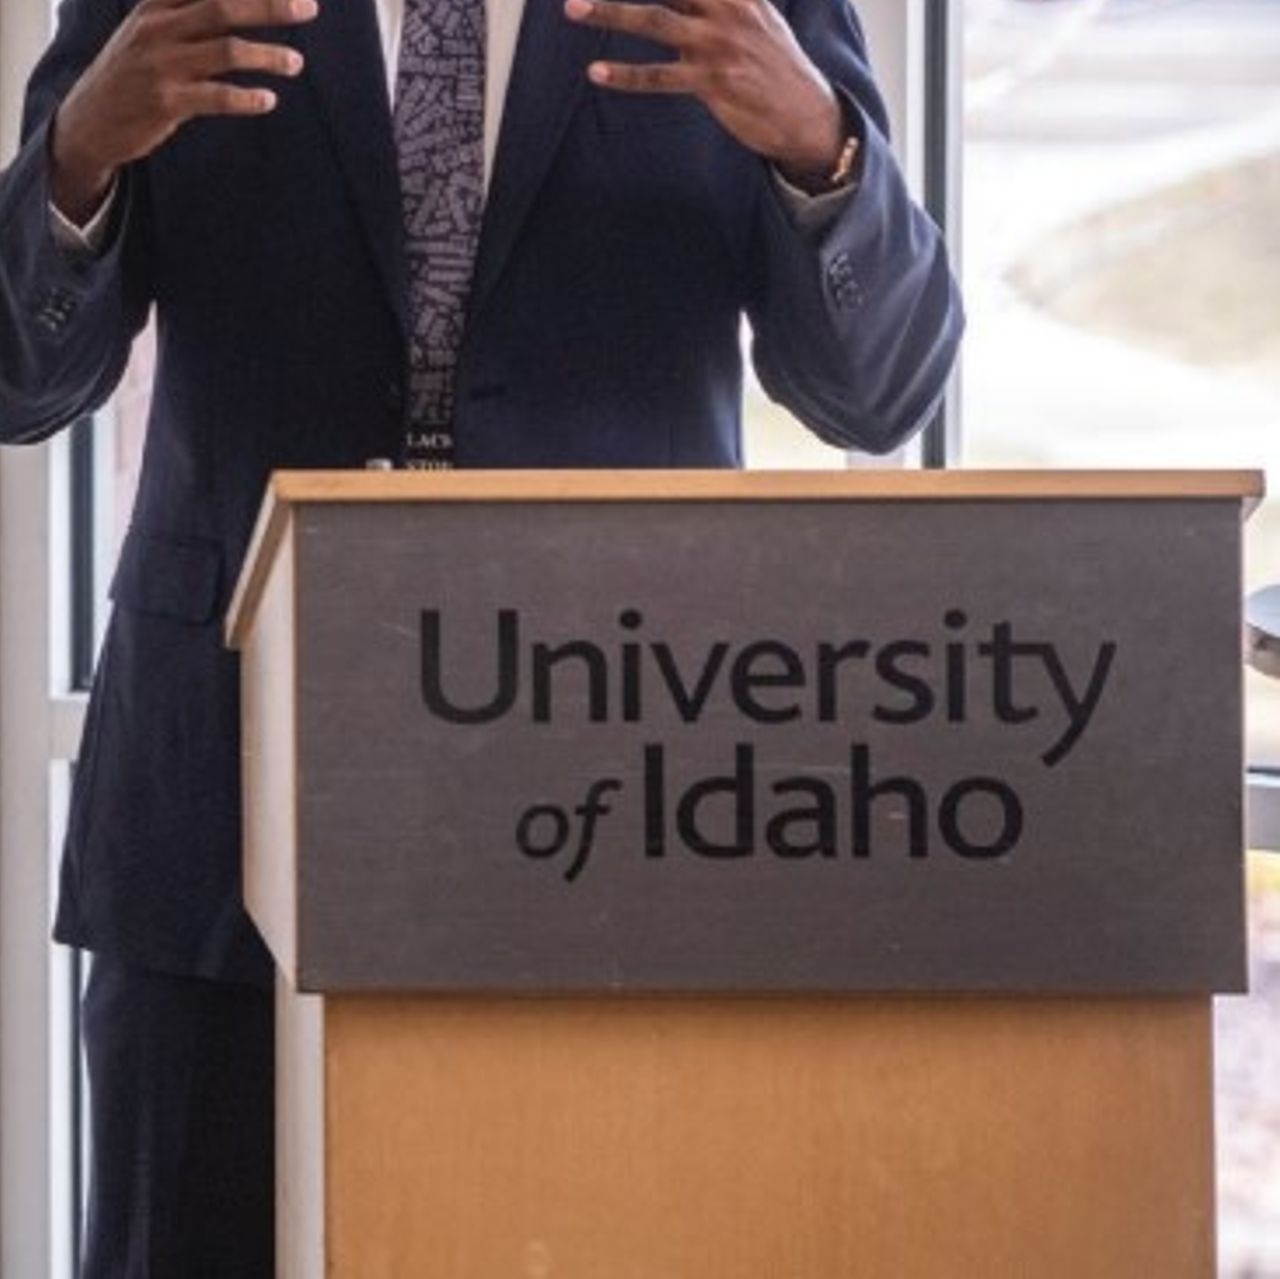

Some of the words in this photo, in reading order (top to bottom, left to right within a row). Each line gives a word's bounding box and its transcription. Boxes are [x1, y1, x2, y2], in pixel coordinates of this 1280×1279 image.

[421, 610, 1116, 767] University
[516, 779, 622, 883] of
[644, 742, 1024, 861] Idaho
